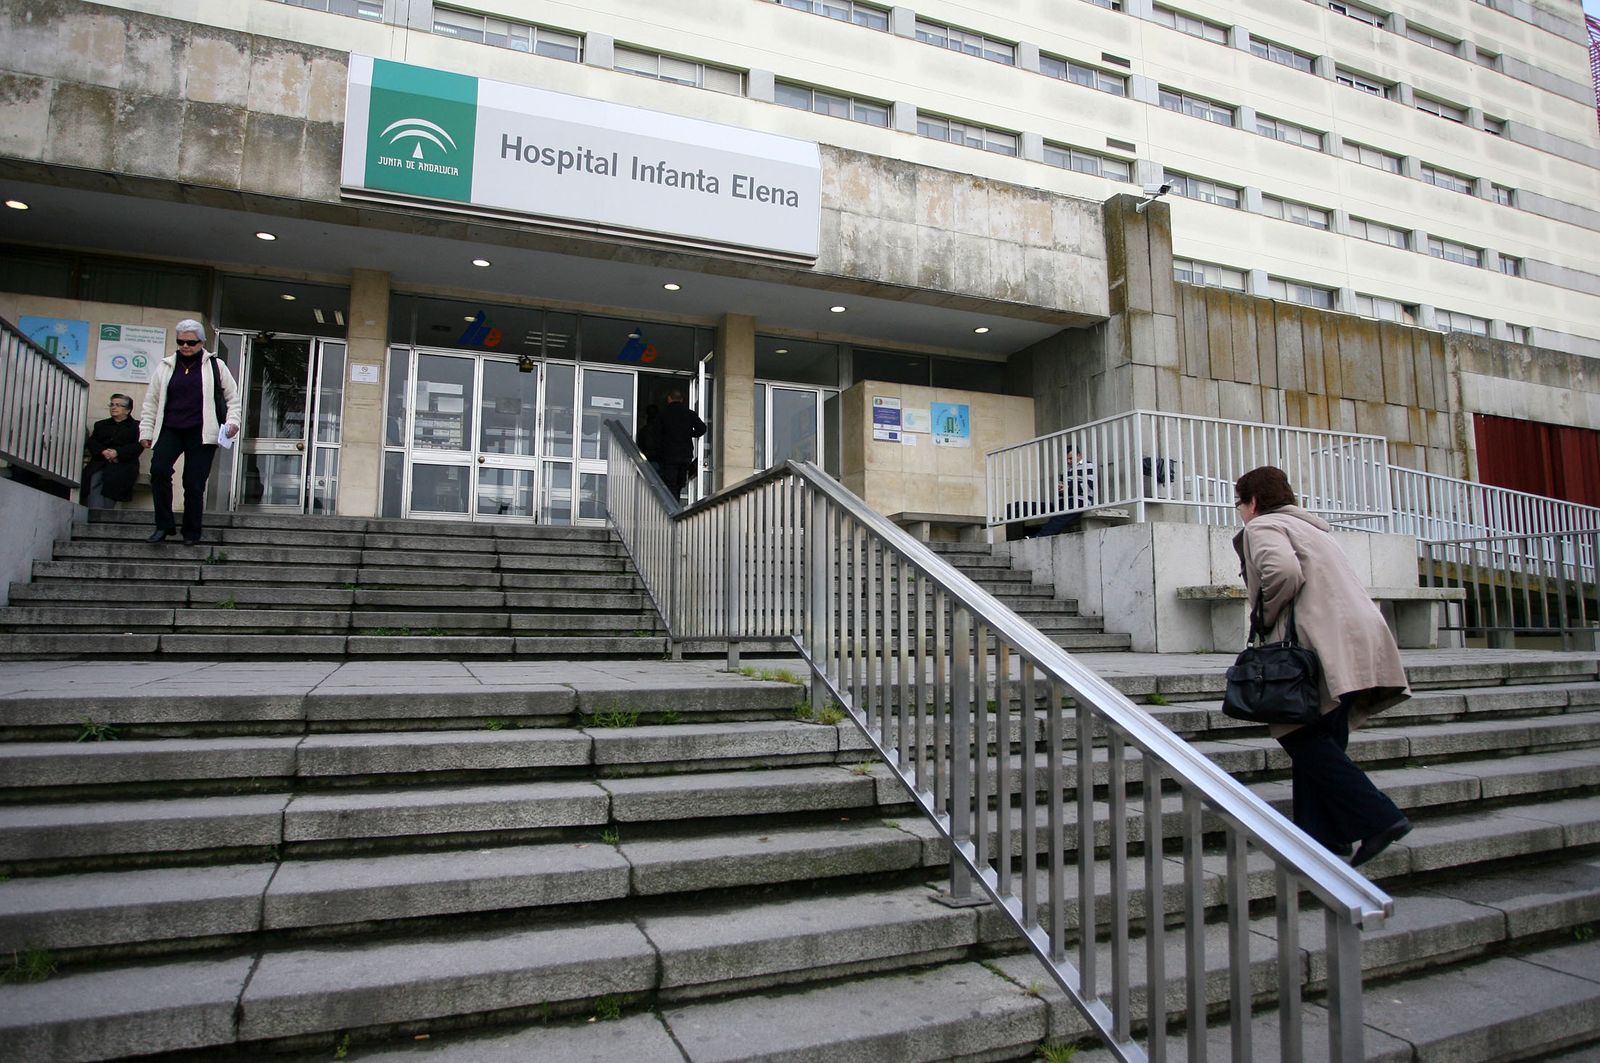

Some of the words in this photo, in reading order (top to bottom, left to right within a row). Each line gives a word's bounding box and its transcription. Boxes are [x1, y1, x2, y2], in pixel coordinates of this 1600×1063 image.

[377, 156, 403, 168] JUNTA
[405, 160, 416, 170] DE
[418, 161, 459, 176] ANDALUCIA
[502, 134, 618, 177] Hospital
[632, 157, 719, 195] Infanta
[733, 175, 799, 208] Elena
